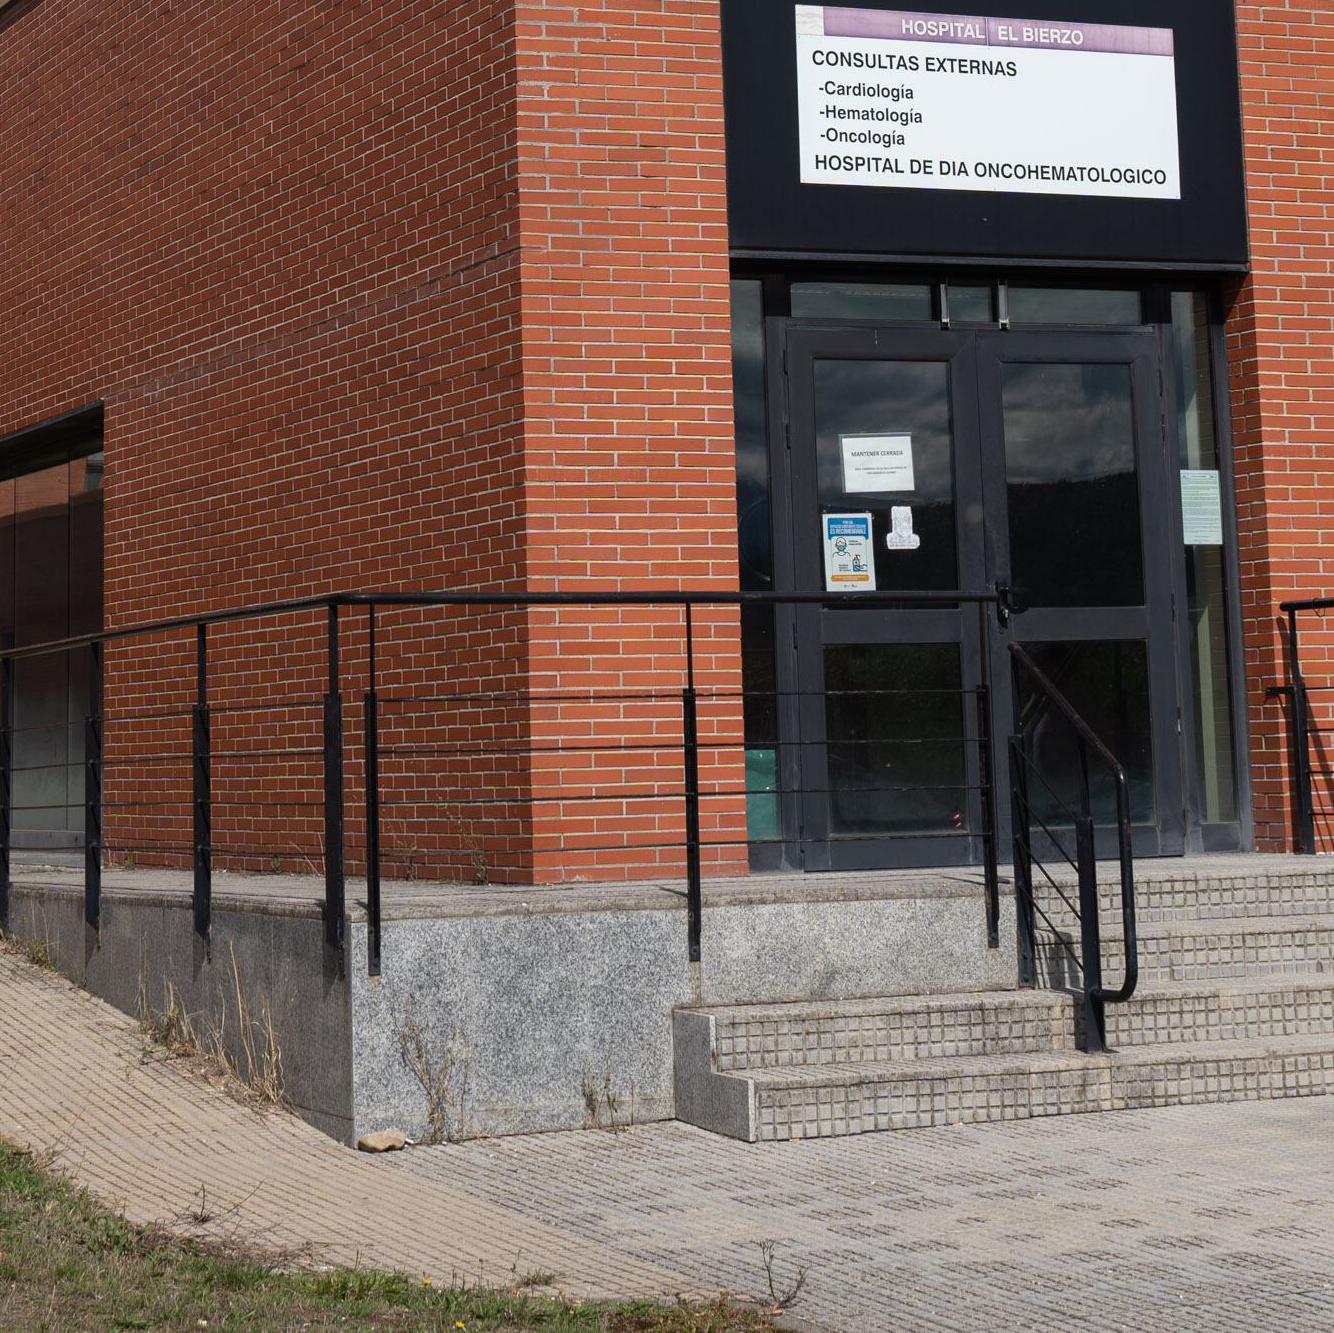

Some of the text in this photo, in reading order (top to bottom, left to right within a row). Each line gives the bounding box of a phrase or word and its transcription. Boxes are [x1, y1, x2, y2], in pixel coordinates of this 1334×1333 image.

[901, 19, 1084, 45] HOSPITAL EL BIERZO
[812, 50, 1017, 77] CONSULTAS EXTERNAS
[818, 81, 914, 102] -Cardiología
[819, 104, 923, 126] -Hematología
[820, 127, 906, 147] -Oncología
[815, 154, 1167, 185] HOSPITAL DE DIA ONCOHEMATOLOGICO
